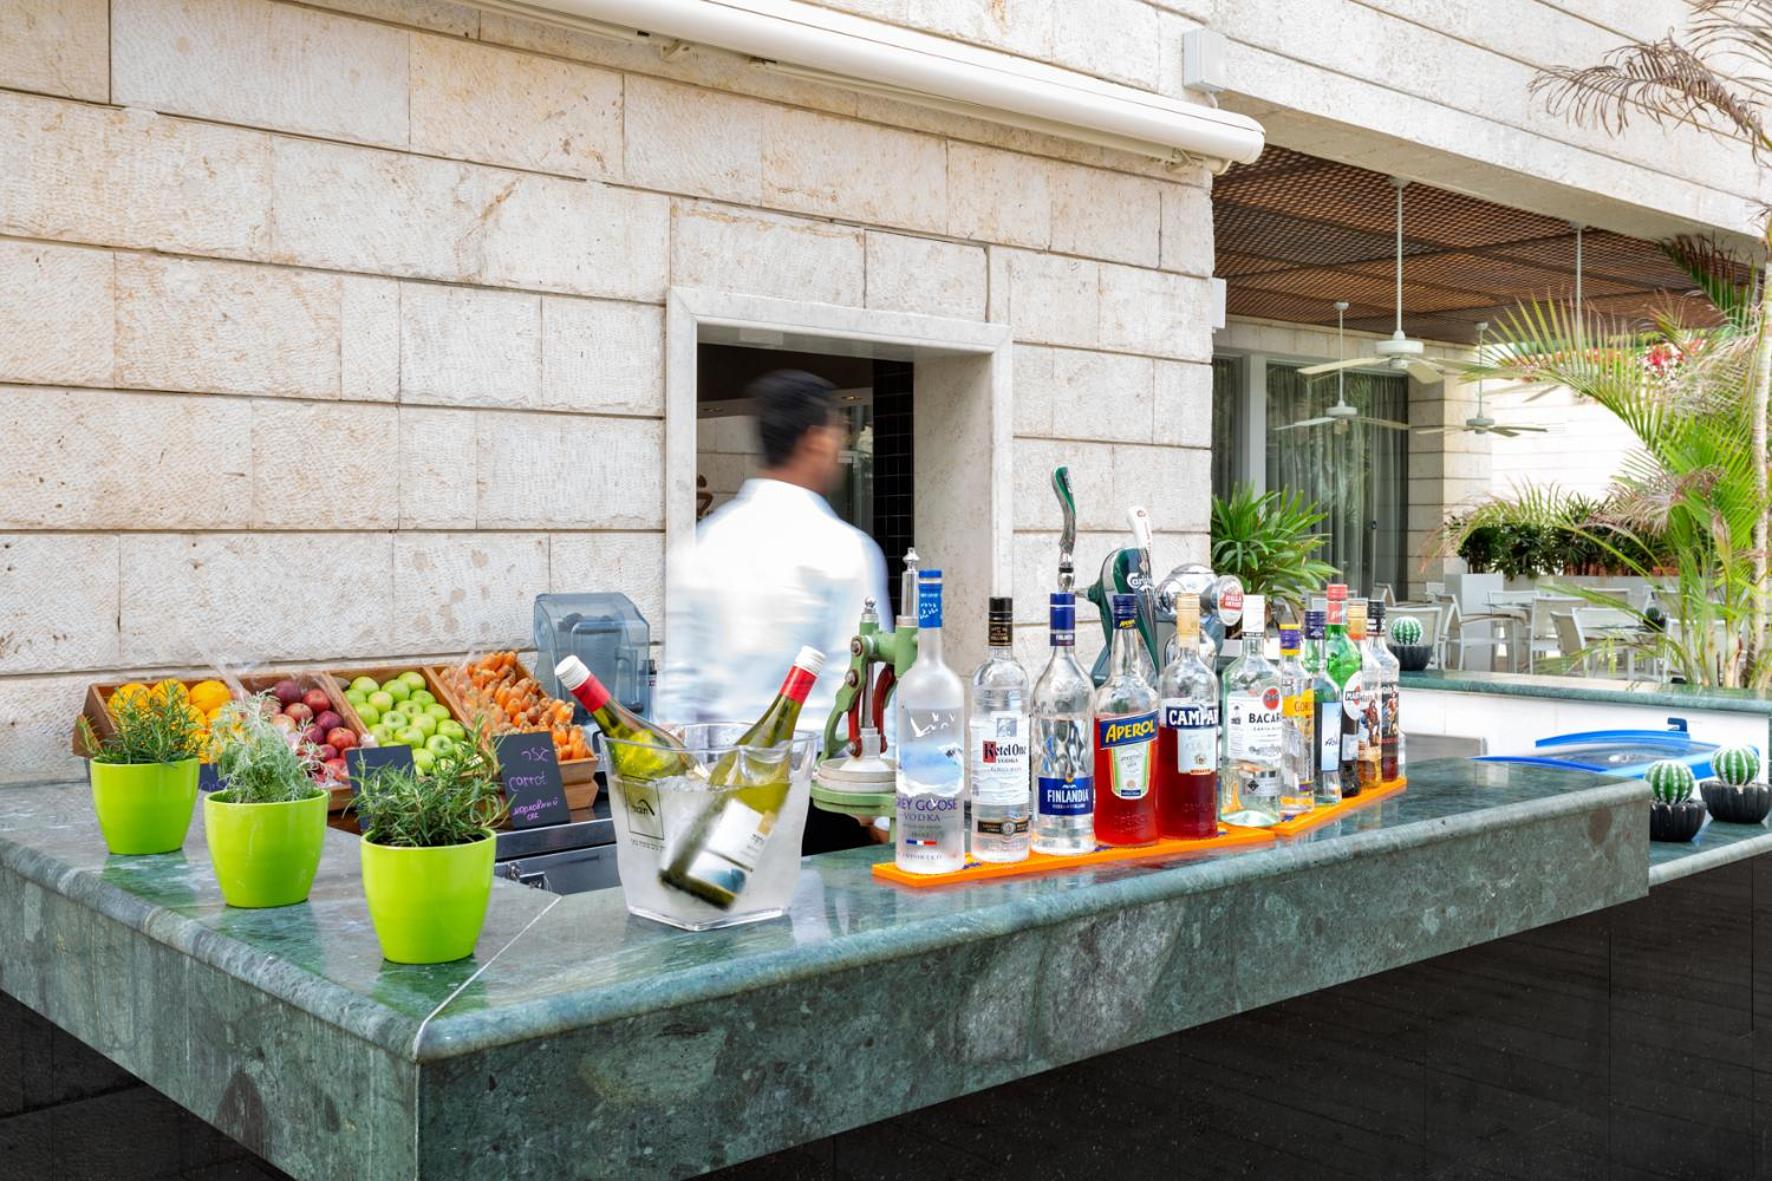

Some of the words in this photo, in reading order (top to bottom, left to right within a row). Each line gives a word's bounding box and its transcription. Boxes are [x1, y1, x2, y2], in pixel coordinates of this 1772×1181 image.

[1105, 720, 1155, 743] APEROL
[984, 743, 1011, 759] Ketel
[1047, 789, 1089, 803] FINLANDIA
[904, 812, 941, 822] VODKA
